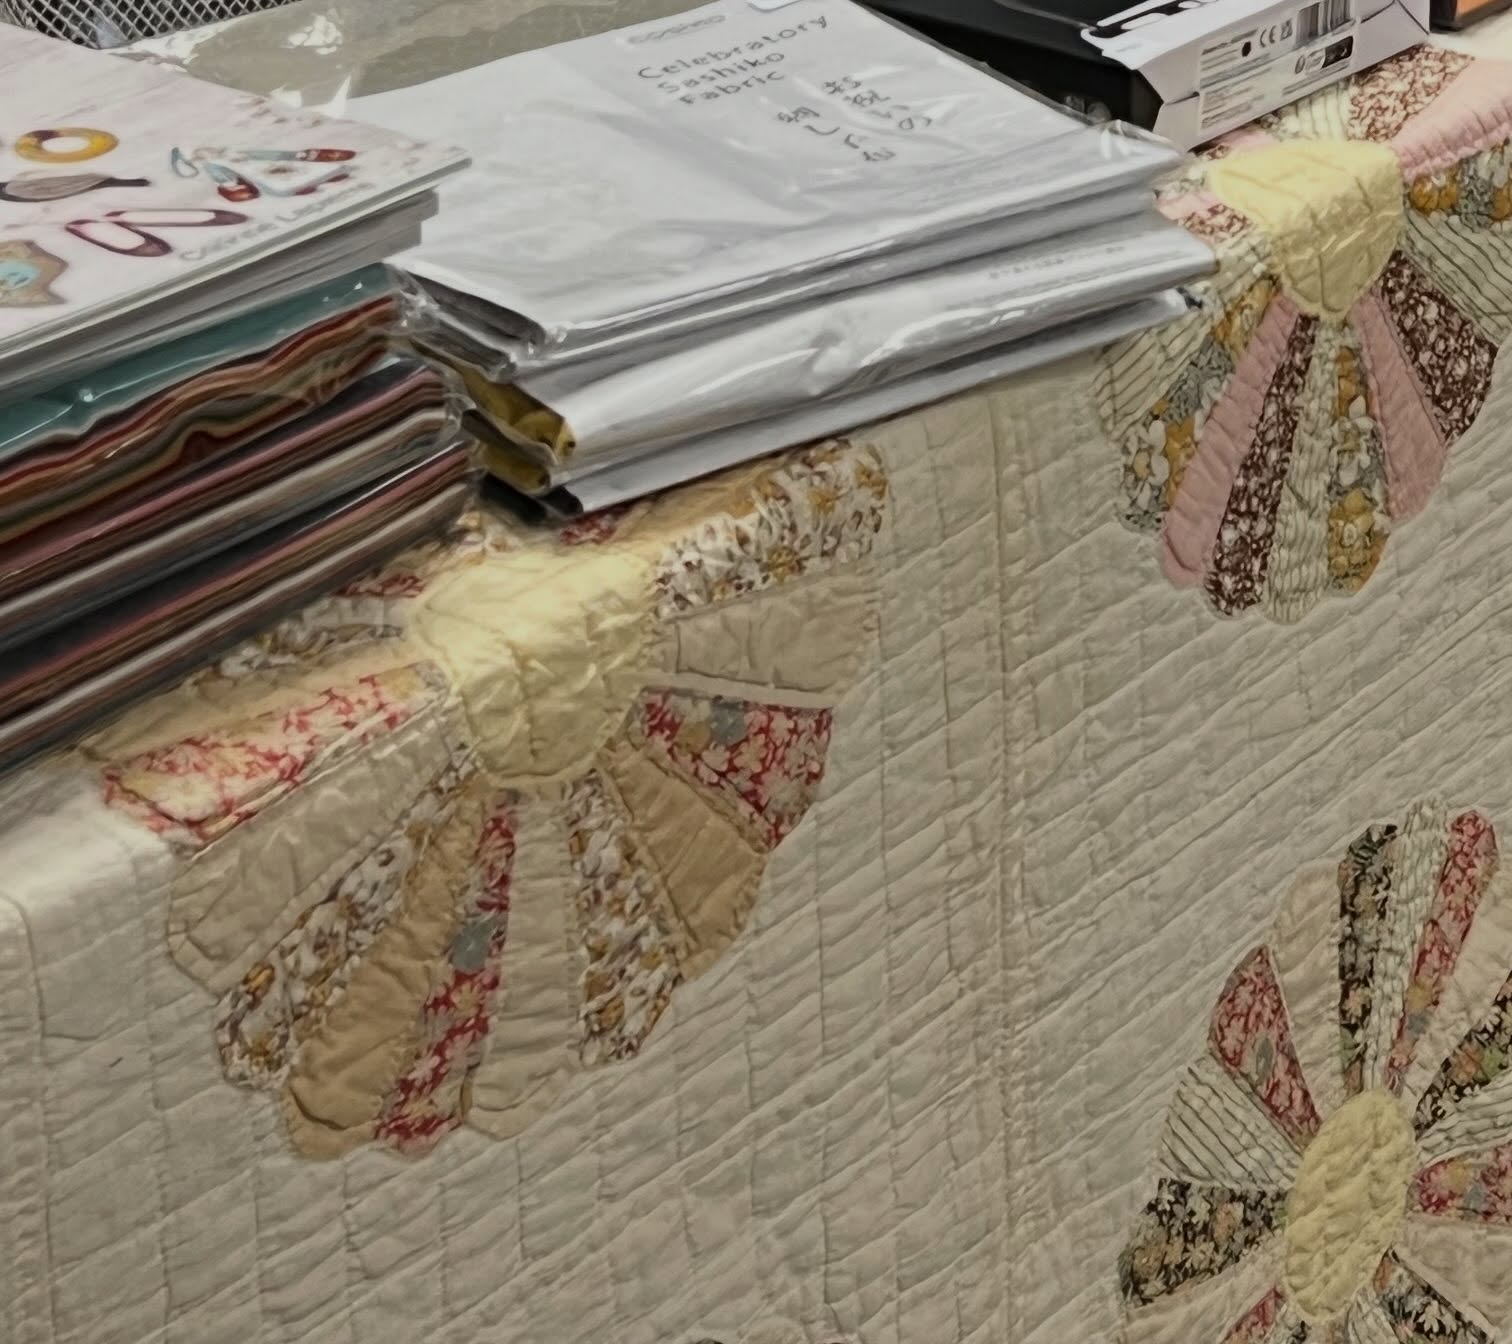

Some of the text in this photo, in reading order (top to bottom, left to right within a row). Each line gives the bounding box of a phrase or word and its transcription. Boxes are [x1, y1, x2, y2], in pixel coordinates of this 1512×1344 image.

[637, 15, 829, 80] Celebratory
[657, 52, 786, 95] Sashiko
[678, 70, 786, 105] Fabric
